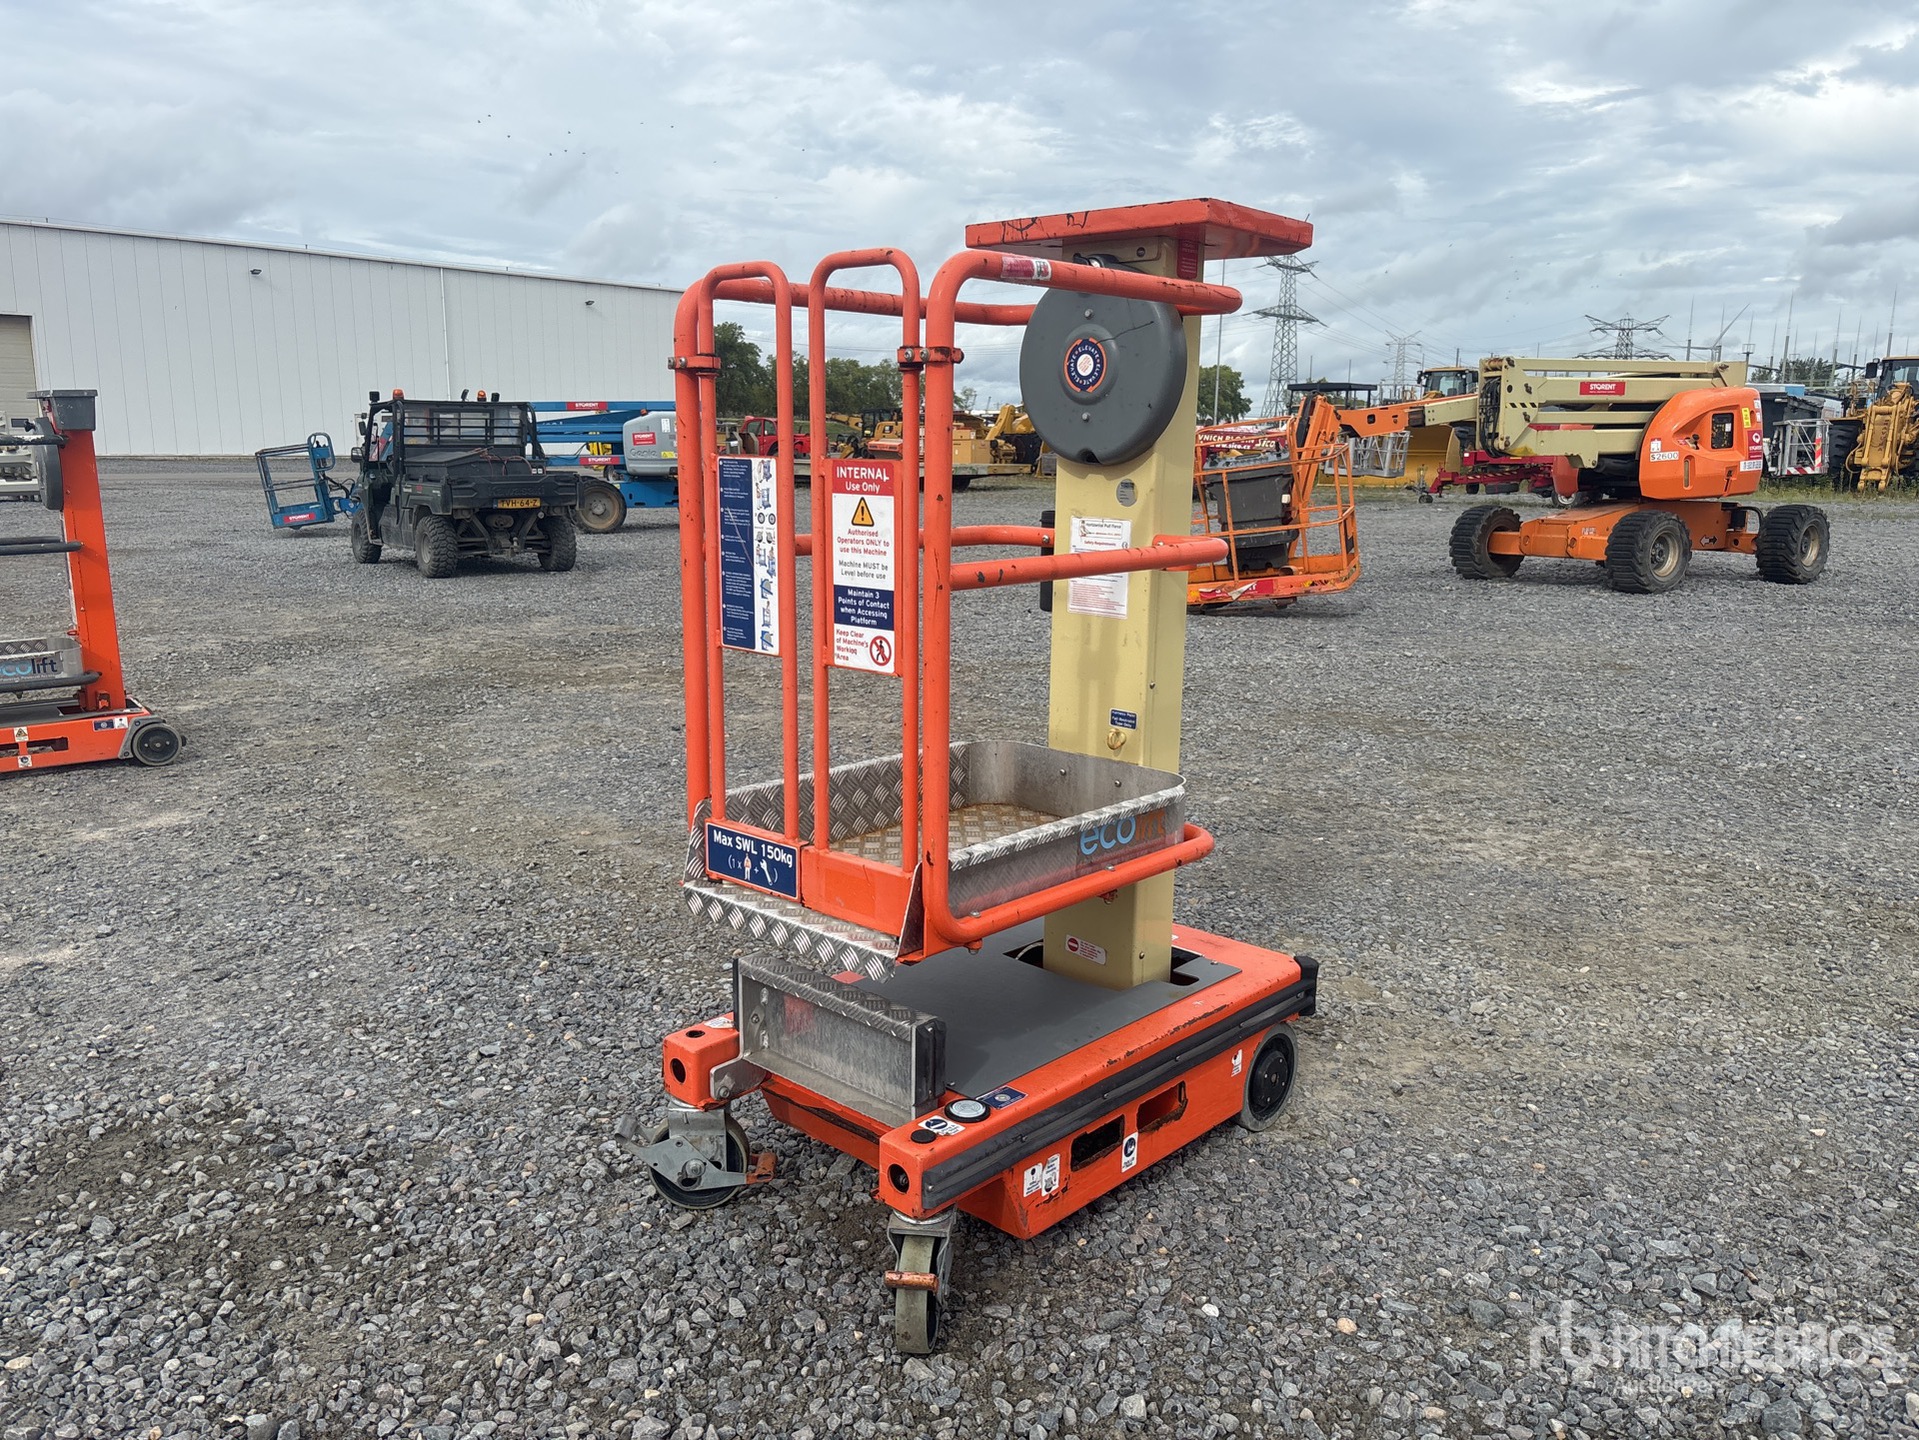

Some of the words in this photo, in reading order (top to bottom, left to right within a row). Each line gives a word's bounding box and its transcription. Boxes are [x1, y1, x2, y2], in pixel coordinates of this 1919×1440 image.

[1590, 383, 1616, 391] STORENT
[630, 448, 657, 457] Genie
[836, 466, 890, 482] INTERNAL
[845, 481, 860, 492] Use
[862, 482, 881, 494] Only
[847, 529, 879, 538] Authorised
[836, 536, 865, 546] Operators
[865, 538, 882, 547] ONLY
[883, 540, 890, 548] to
[863, 547, 887, 556] Machine
[838, 560, 862, 569] Machine
[863, 562, 880, 570] MUST
[881, 563, 888, 571] be
[841, 568, 856, 576] Level
[857, 570, 875, 579] before
[876, 572, 886, 580] use
[847, 588, 874, 598] Maintain
[875, 591, 880, 599] 3
[838, 596, 857, 606] Points
[858, 599, 865, 607] of
[865, 599, 890, 609] Contact
[840, 606, 856, 614] when
[857, 608, 888, 619] Accessing
[850, 616, 877, 626] Platform
[836, 629, 849, 637] Keep
[850, 630, 864, 638] Clear
[842, 638, 868, 648] Machine's
[836, 645, 857, 655] Working
[836, 653, 849, 661] Area
[0, 657, 57, 676] colift
[713, 829, 733, 848] Max
[735, 836, 758, 855] SWL
[761, 843, 793, 868] 150kg
